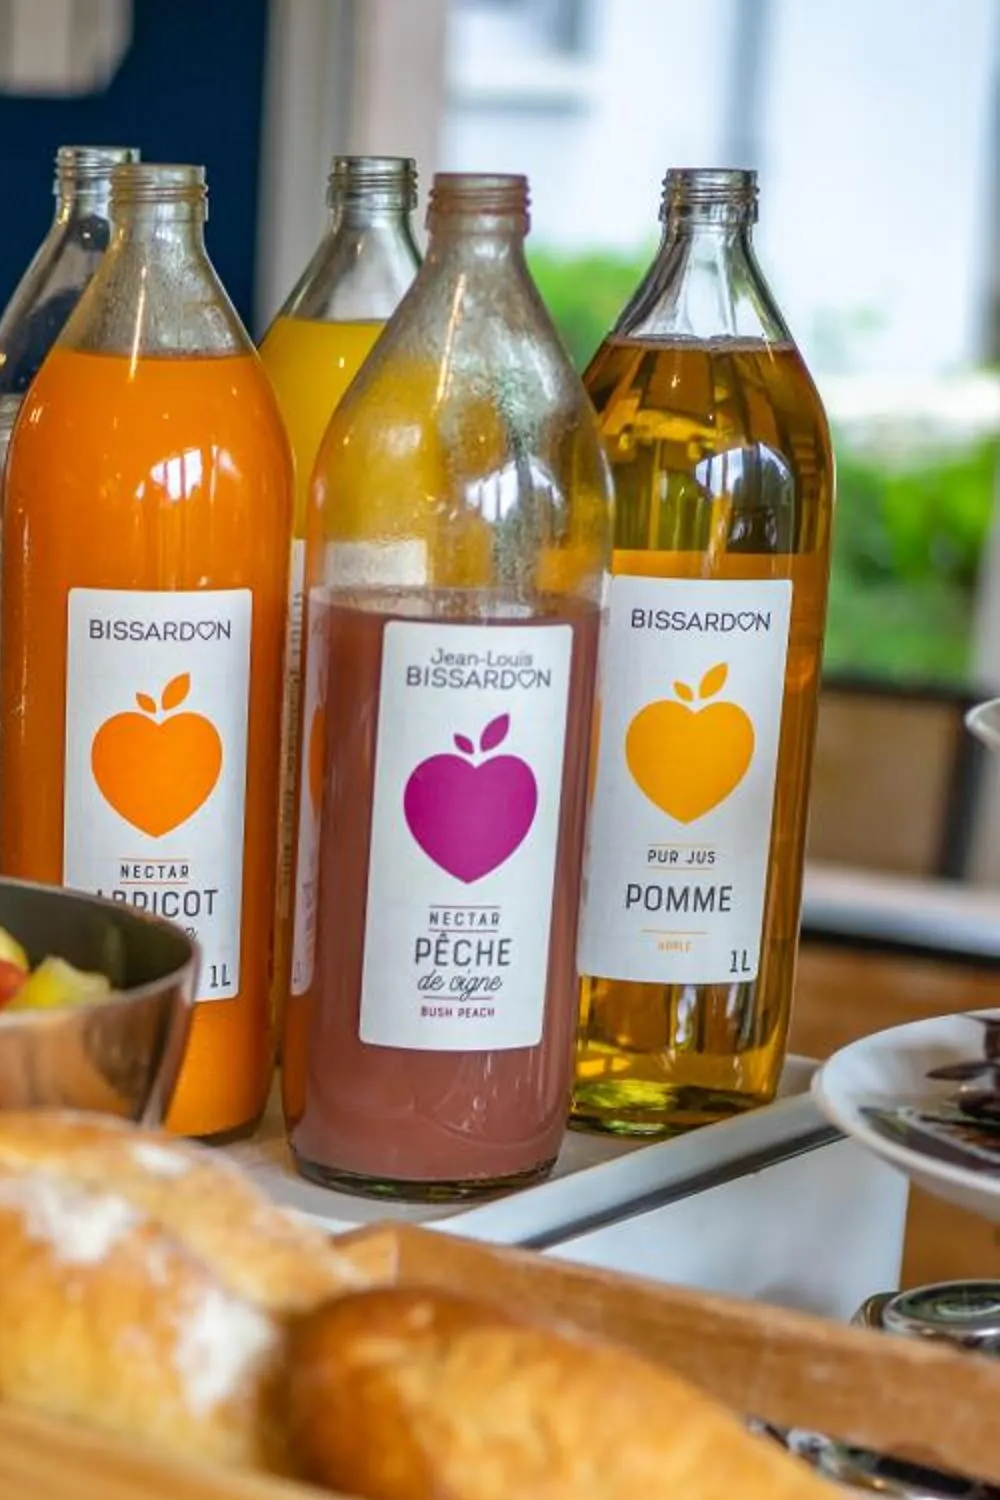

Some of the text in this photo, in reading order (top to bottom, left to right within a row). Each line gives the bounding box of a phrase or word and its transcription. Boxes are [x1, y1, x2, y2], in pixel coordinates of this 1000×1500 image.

[430, 648, 533, 667] Jean-Louis
[647, 849, 716, 864] PUR JUS
[120, 864, 189, 879] NECTAR
[625, 883, 732, 913] POMME
[429, 912, 501, 927] NECTAR
[415, 931, 512, 966] PÊCHE
[729, 949, 751, 973] 1L
[209, 964, 231, 987] 1L
[417, 971, 444, 992] de
[420, 1006, 495, 1019] BUSH PEACH
